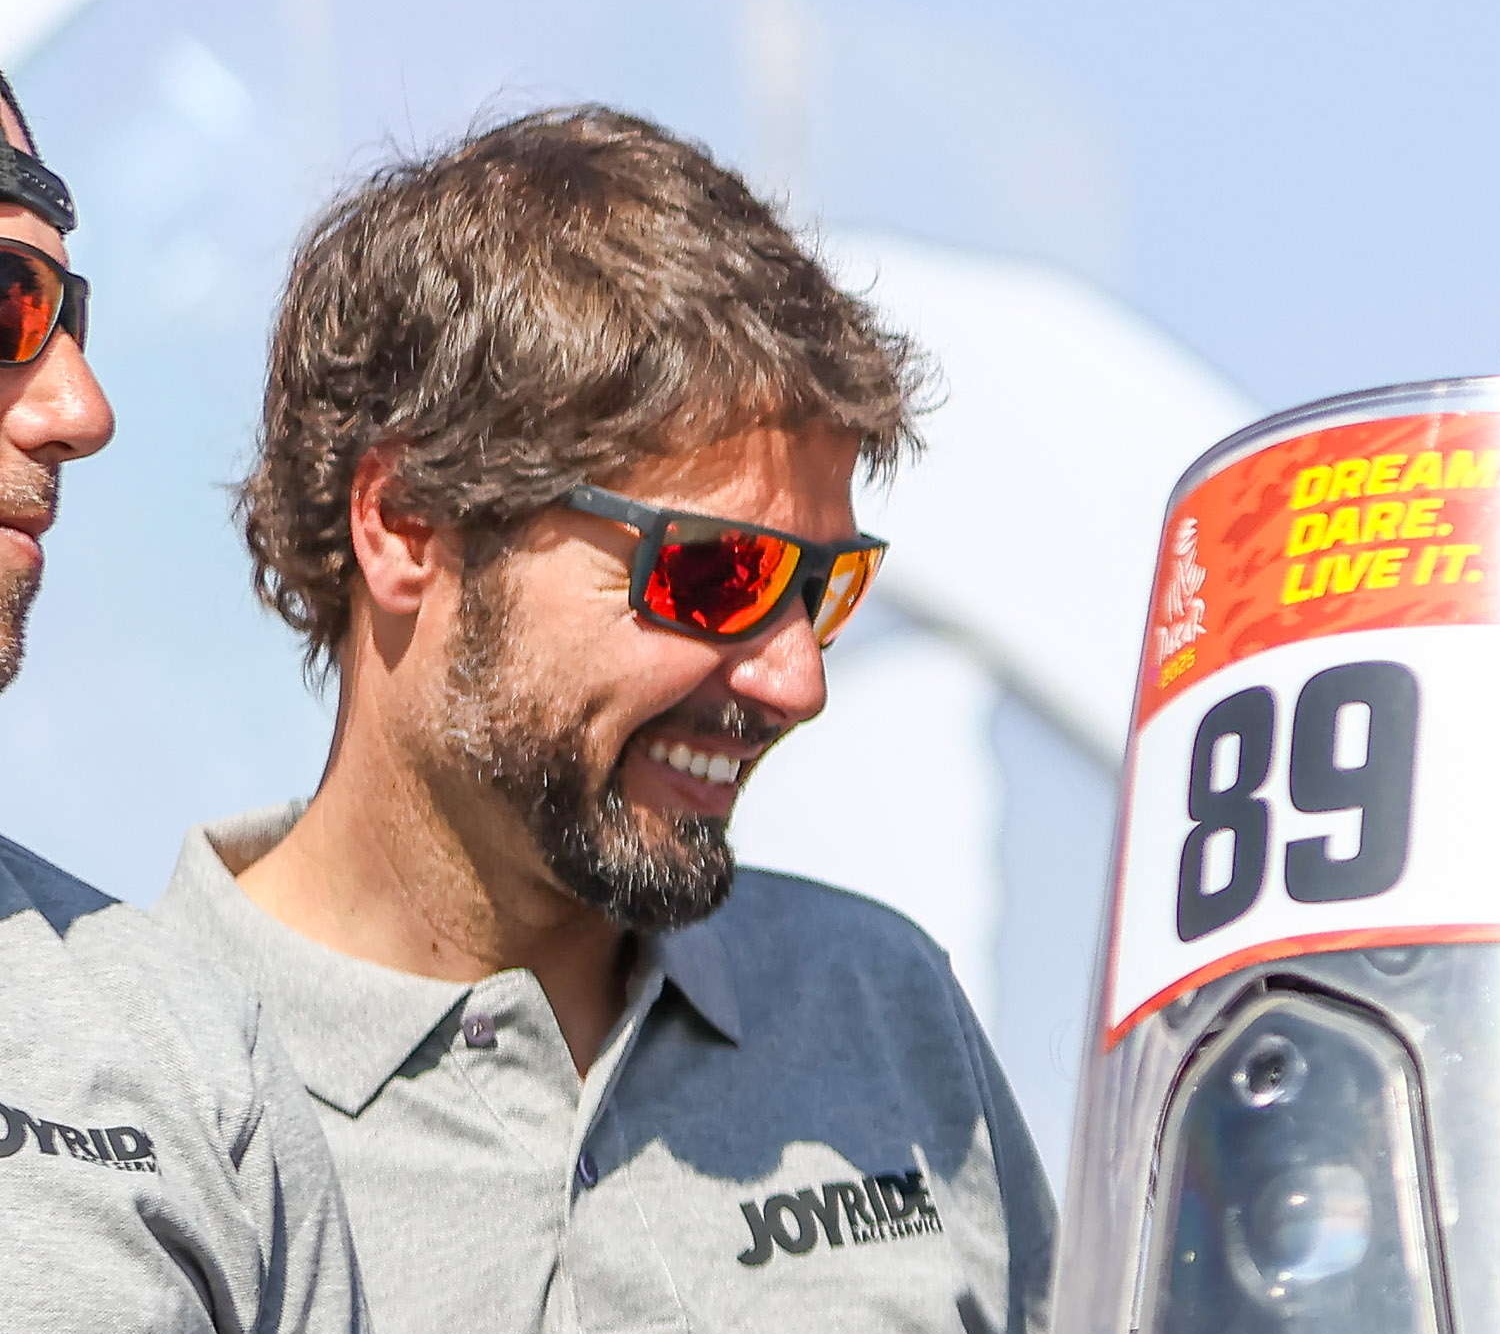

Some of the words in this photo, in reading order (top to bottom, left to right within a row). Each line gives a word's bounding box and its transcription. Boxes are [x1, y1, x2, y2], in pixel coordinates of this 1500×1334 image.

[1286, 499, 1455, 558] DARE.
[1280, 547, 1409, 606] LIVE
[1413, 543, 1485, 586] IT.
[1158, 646, 1197, 689] 2025
[1176, 659, 1421, 943] 89
[737, 1170, 937, 1267] JOYRIDE
